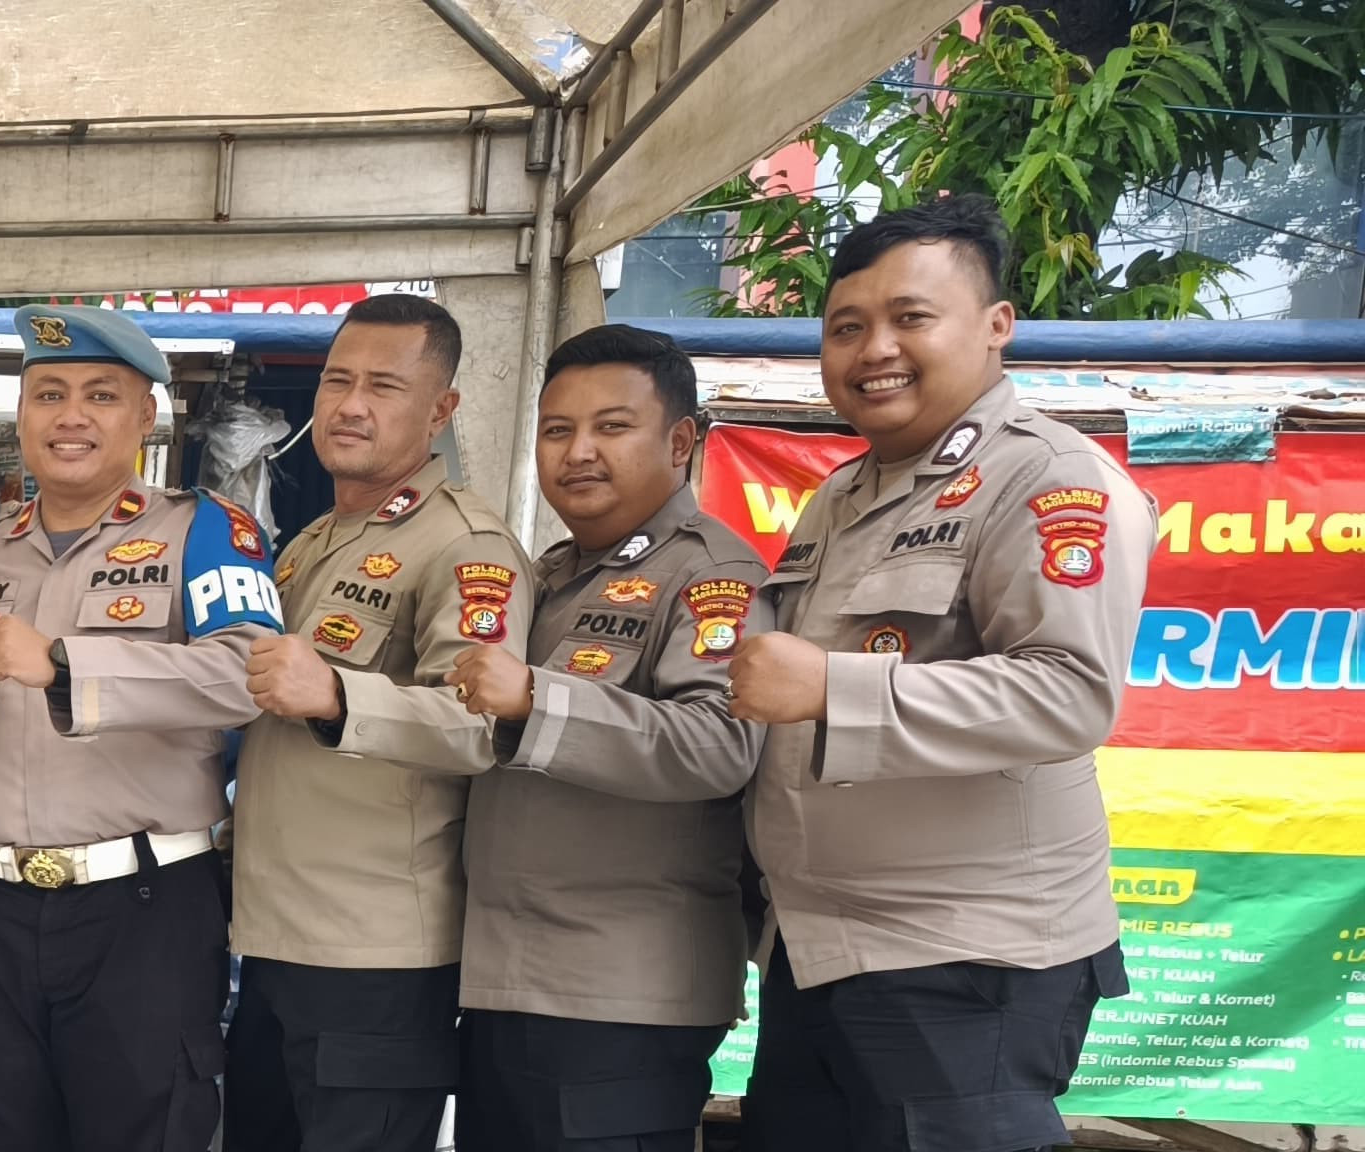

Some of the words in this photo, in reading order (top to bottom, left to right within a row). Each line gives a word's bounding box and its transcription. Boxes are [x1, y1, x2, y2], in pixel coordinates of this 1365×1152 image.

[891, 521, 961, 552] POLRI
[90, 565, 169, 588] POLRI
[690, 581, 747, 594] POLSEK
[331, 581, 392, 611] POLRI
[574, 613, 648, 640] POLRI
[1111, 878, 1180, 896] nan
[1162, 921, 1233, 938] REBUS
[1164, 969, 1216, 983] KUAH
[1215, 994, 1276, 1007] Kornet)
[1180, 1014, 1228, 1026] KUAH
[1145, 1034, 1187, 1048] Telur,
[1191, 1035, 1227, 1049] Keju
[1230, 1035, 1242, 1047] &
[1101, 1054, 1171, 1068] (Indomie
[1174, 1055, 1224, 1069] Rebus
[1125, 1075, 1175, 1088] Rebus
